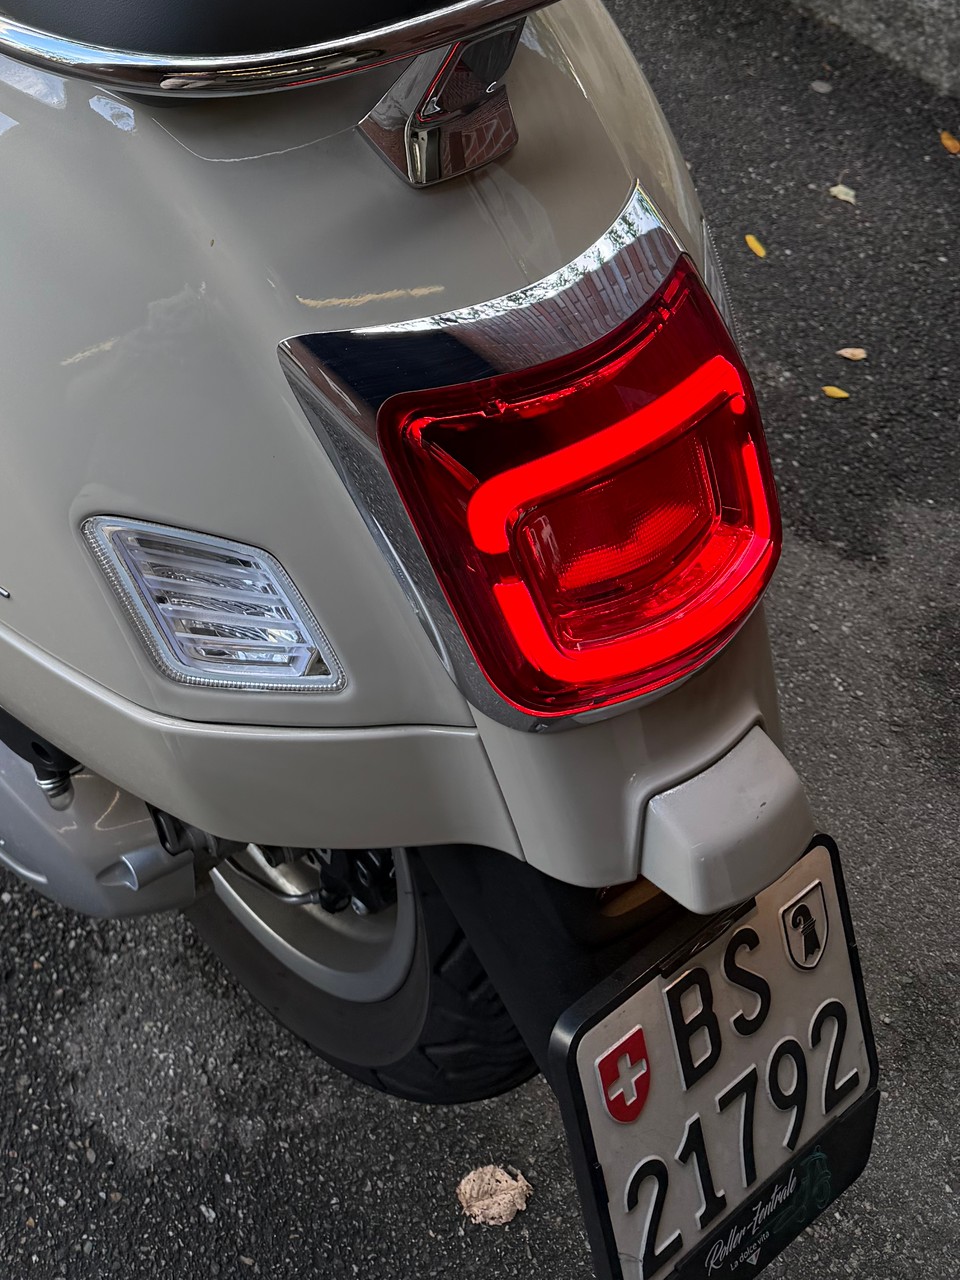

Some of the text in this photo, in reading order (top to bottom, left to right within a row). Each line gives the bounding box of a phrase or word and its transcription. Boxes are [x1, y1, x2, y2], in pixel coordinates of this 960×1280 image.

[662, 926, 771, 1091] BS
[625, 997, 860, 1280] 21792
[705, 1168, 797, 1276] Roller-Zentrale
[740, 1242, 757, 1263] dolce
[758, 1231, 770, 1245] vita
